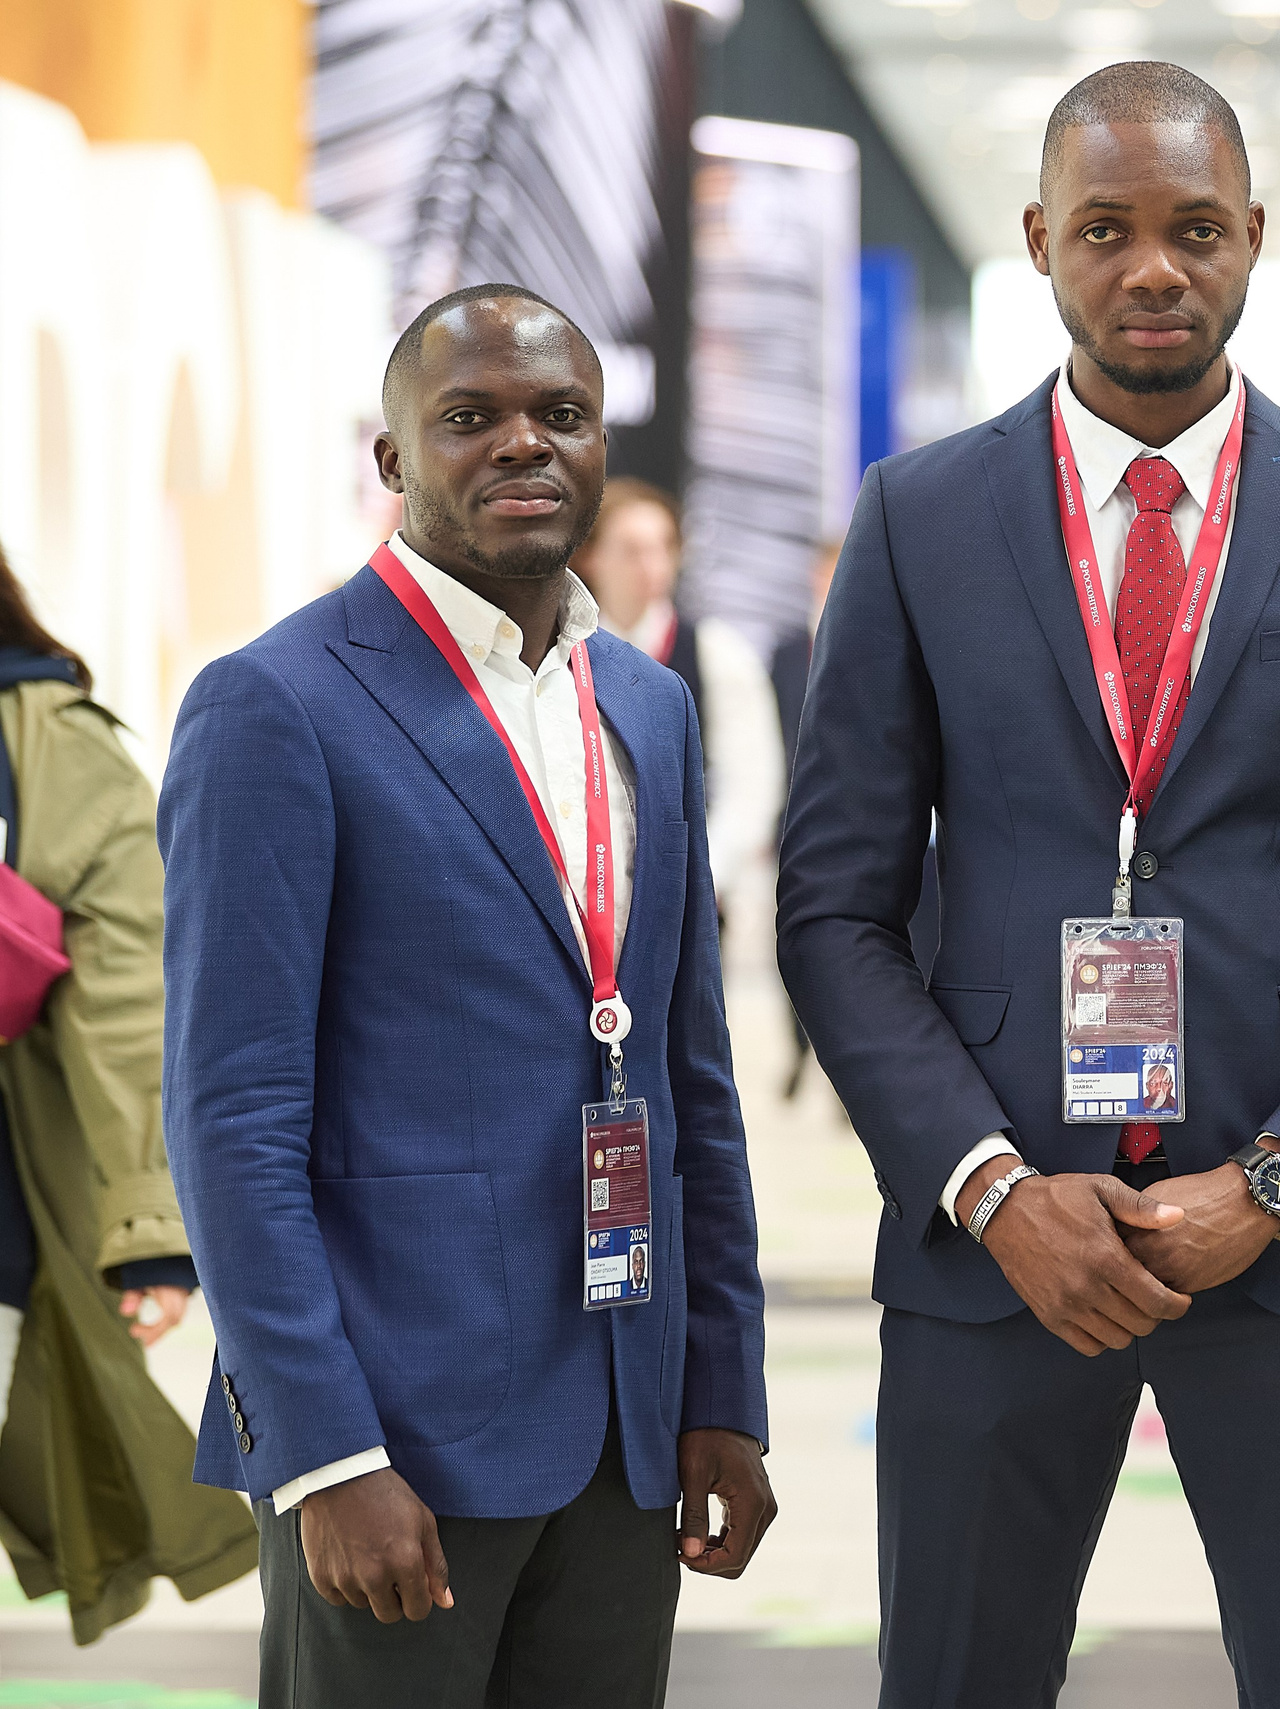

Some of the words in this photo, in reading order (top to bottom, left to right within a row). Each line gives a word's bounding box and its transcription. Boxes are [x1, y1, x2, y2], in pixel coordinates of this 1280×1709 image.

[1059, 460, 1076, 516] ROSCONGRESS
[1214, 460, 1233, 516] РОСКОНГРЕСС
[1082, 568, 1101, 627] РОСКОНГРЕСС
[1184, 566, 1207, 624] ROSCONGRESS
[575, 641, 589, 688] OSCONGRESS
[1107, 681, 1128, 740] ROSCONGRESS
[1153, 677, 1175, 738] РОСКОНГРЕСС
[590, 739, 602, 799] РОСКОНГРЕСС
[596, 853, 605, 913] ROSCONGRESS
[1142, 1048, 1175, 1060] 2024
[629, 1228, 648, 1242] 2024
